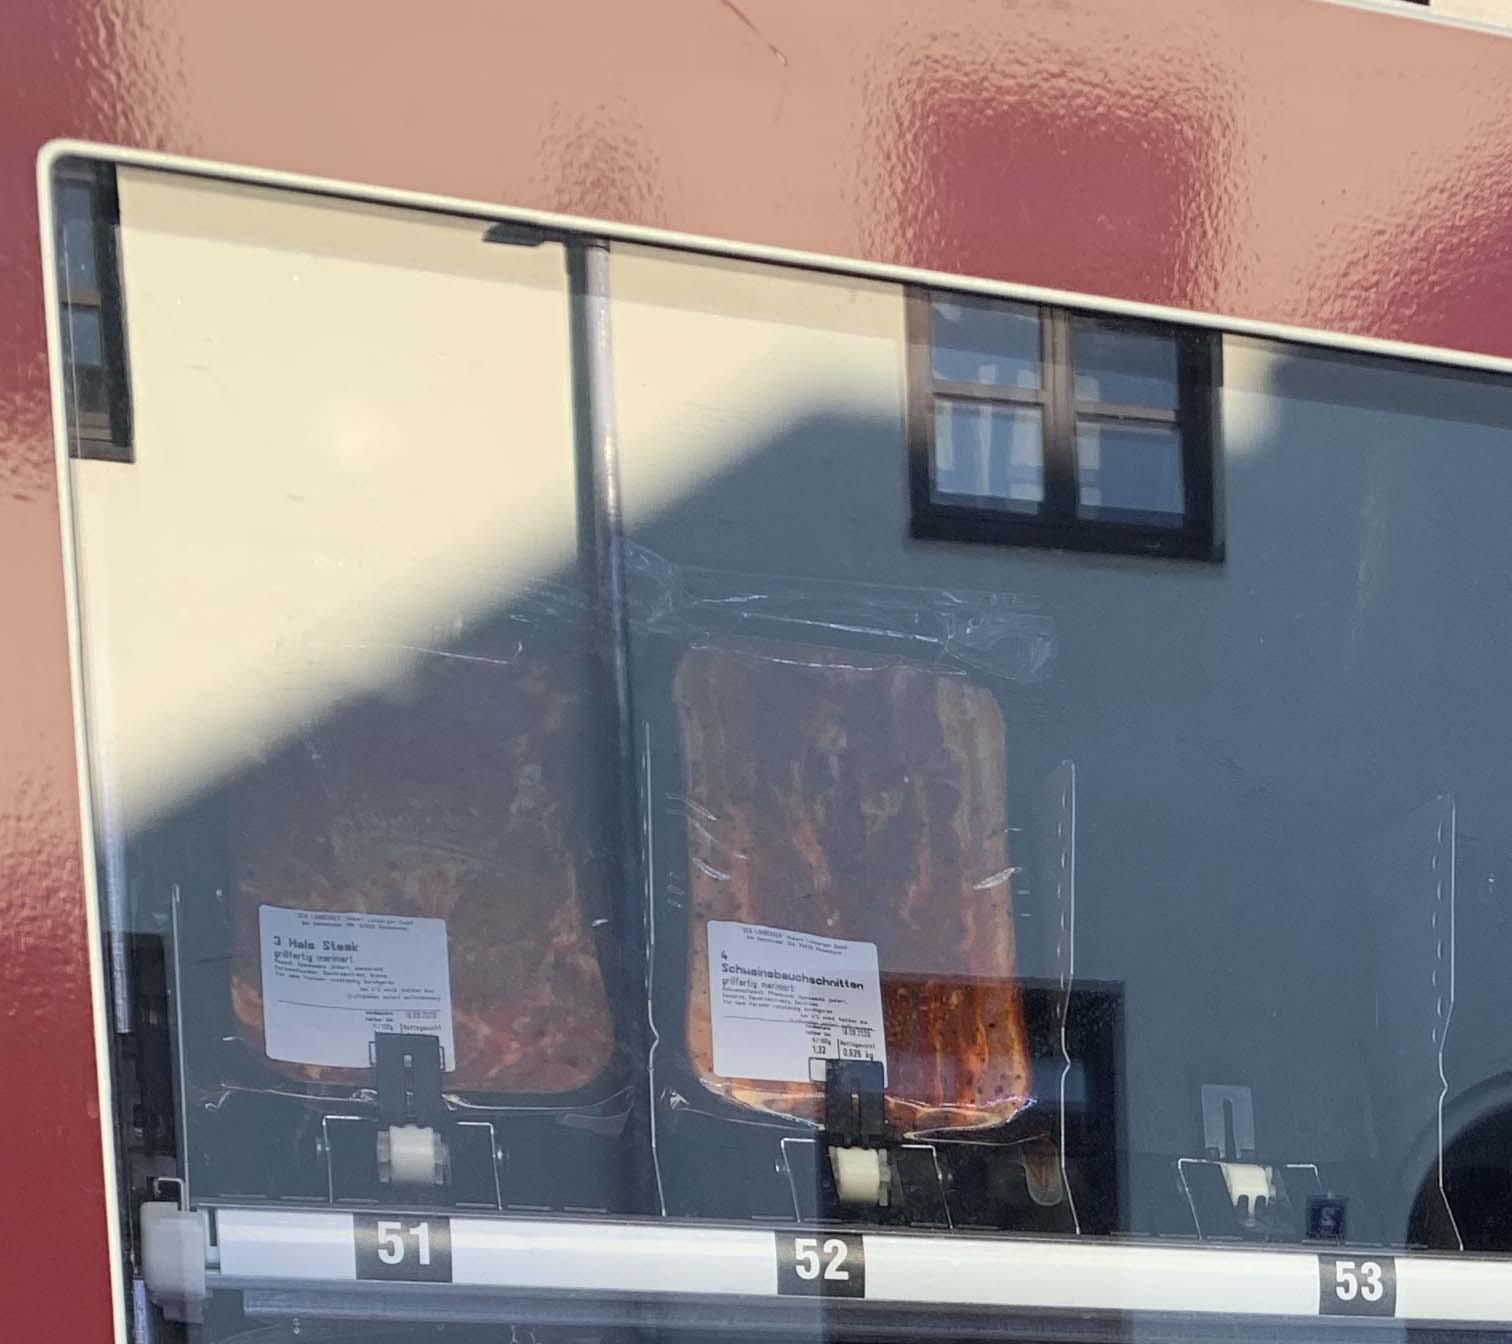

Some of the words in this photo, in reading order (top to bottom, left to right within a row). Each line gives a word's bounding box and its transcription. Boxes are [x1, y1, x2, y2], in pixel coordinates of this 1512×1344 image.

[377, 1221, 431, 1265] 51
[795, 1237, 849, 1281] 52
[1335, 1261, 1383, 1302] 53
